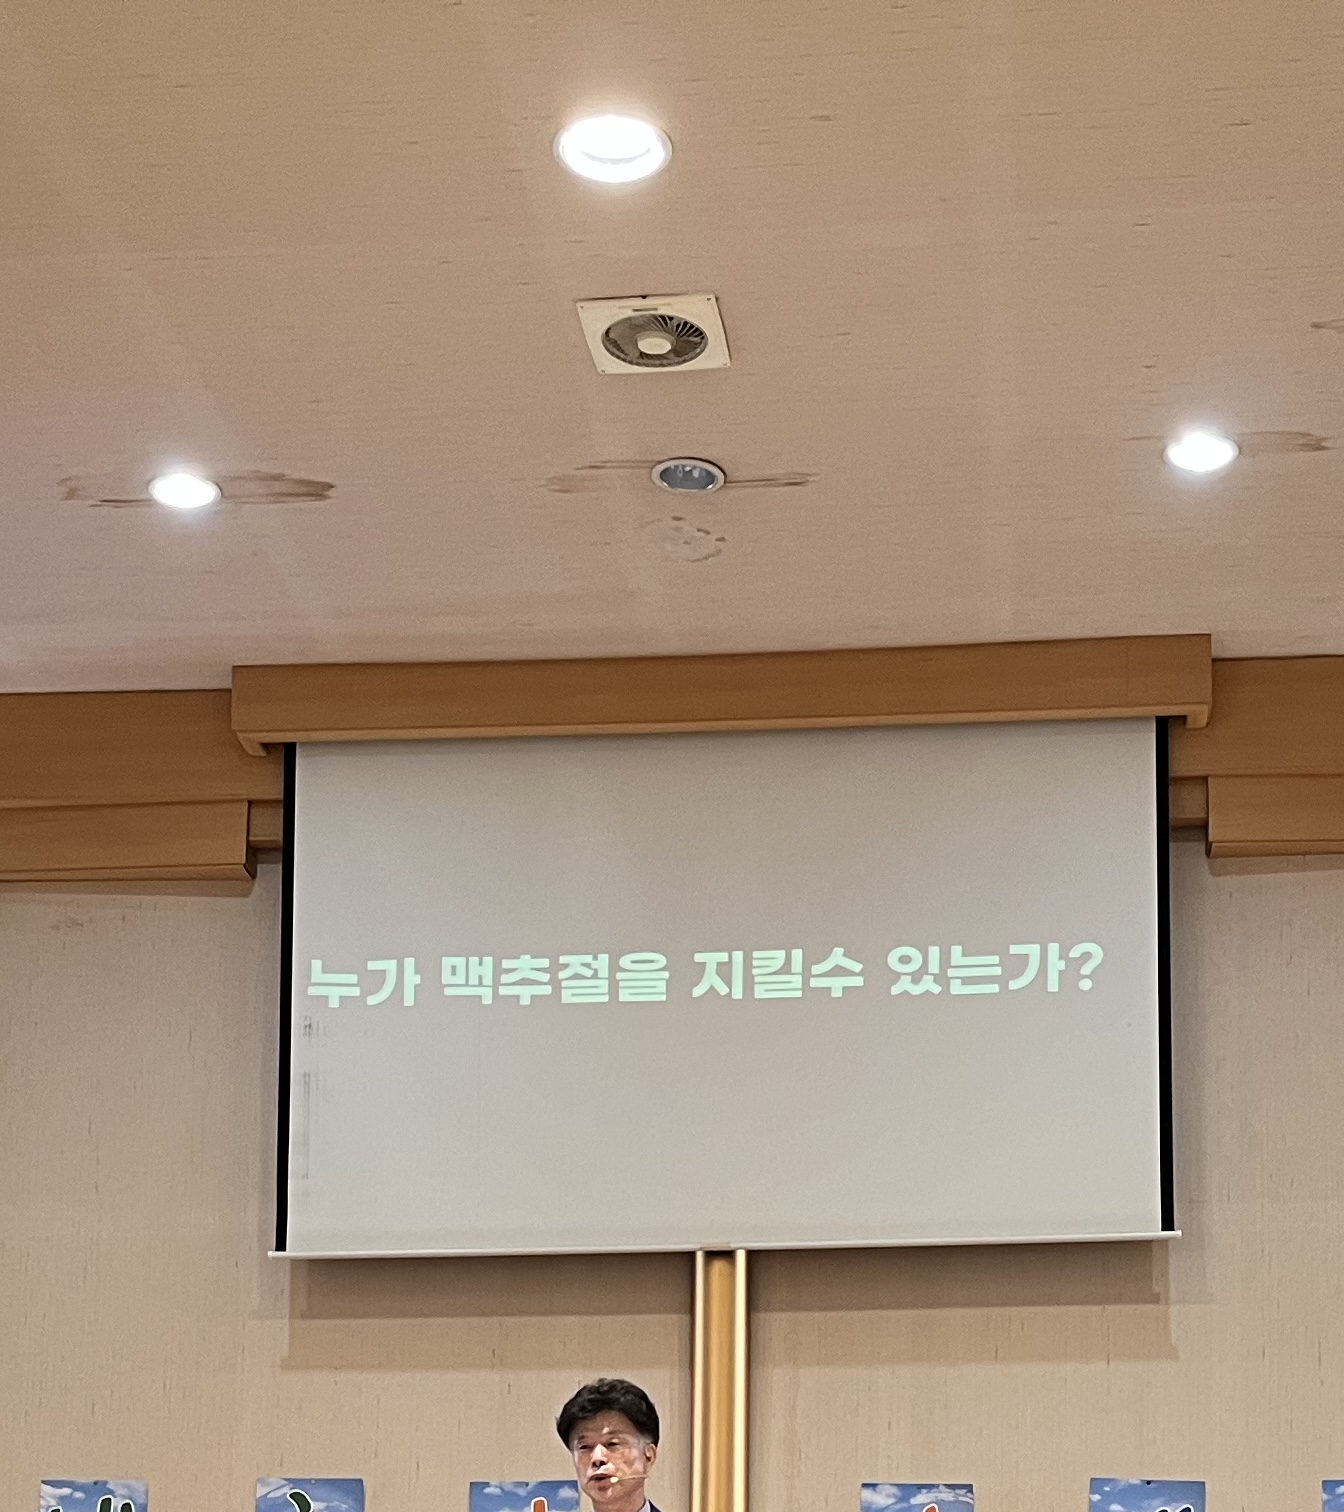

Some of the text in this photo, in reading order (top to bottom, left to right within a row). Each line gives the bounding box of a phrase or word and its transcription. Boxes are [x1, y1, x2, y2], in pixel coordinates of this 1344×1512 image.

[307, 942, 1104, 1008] 누가 맥추절을 지킬수 있는가?
